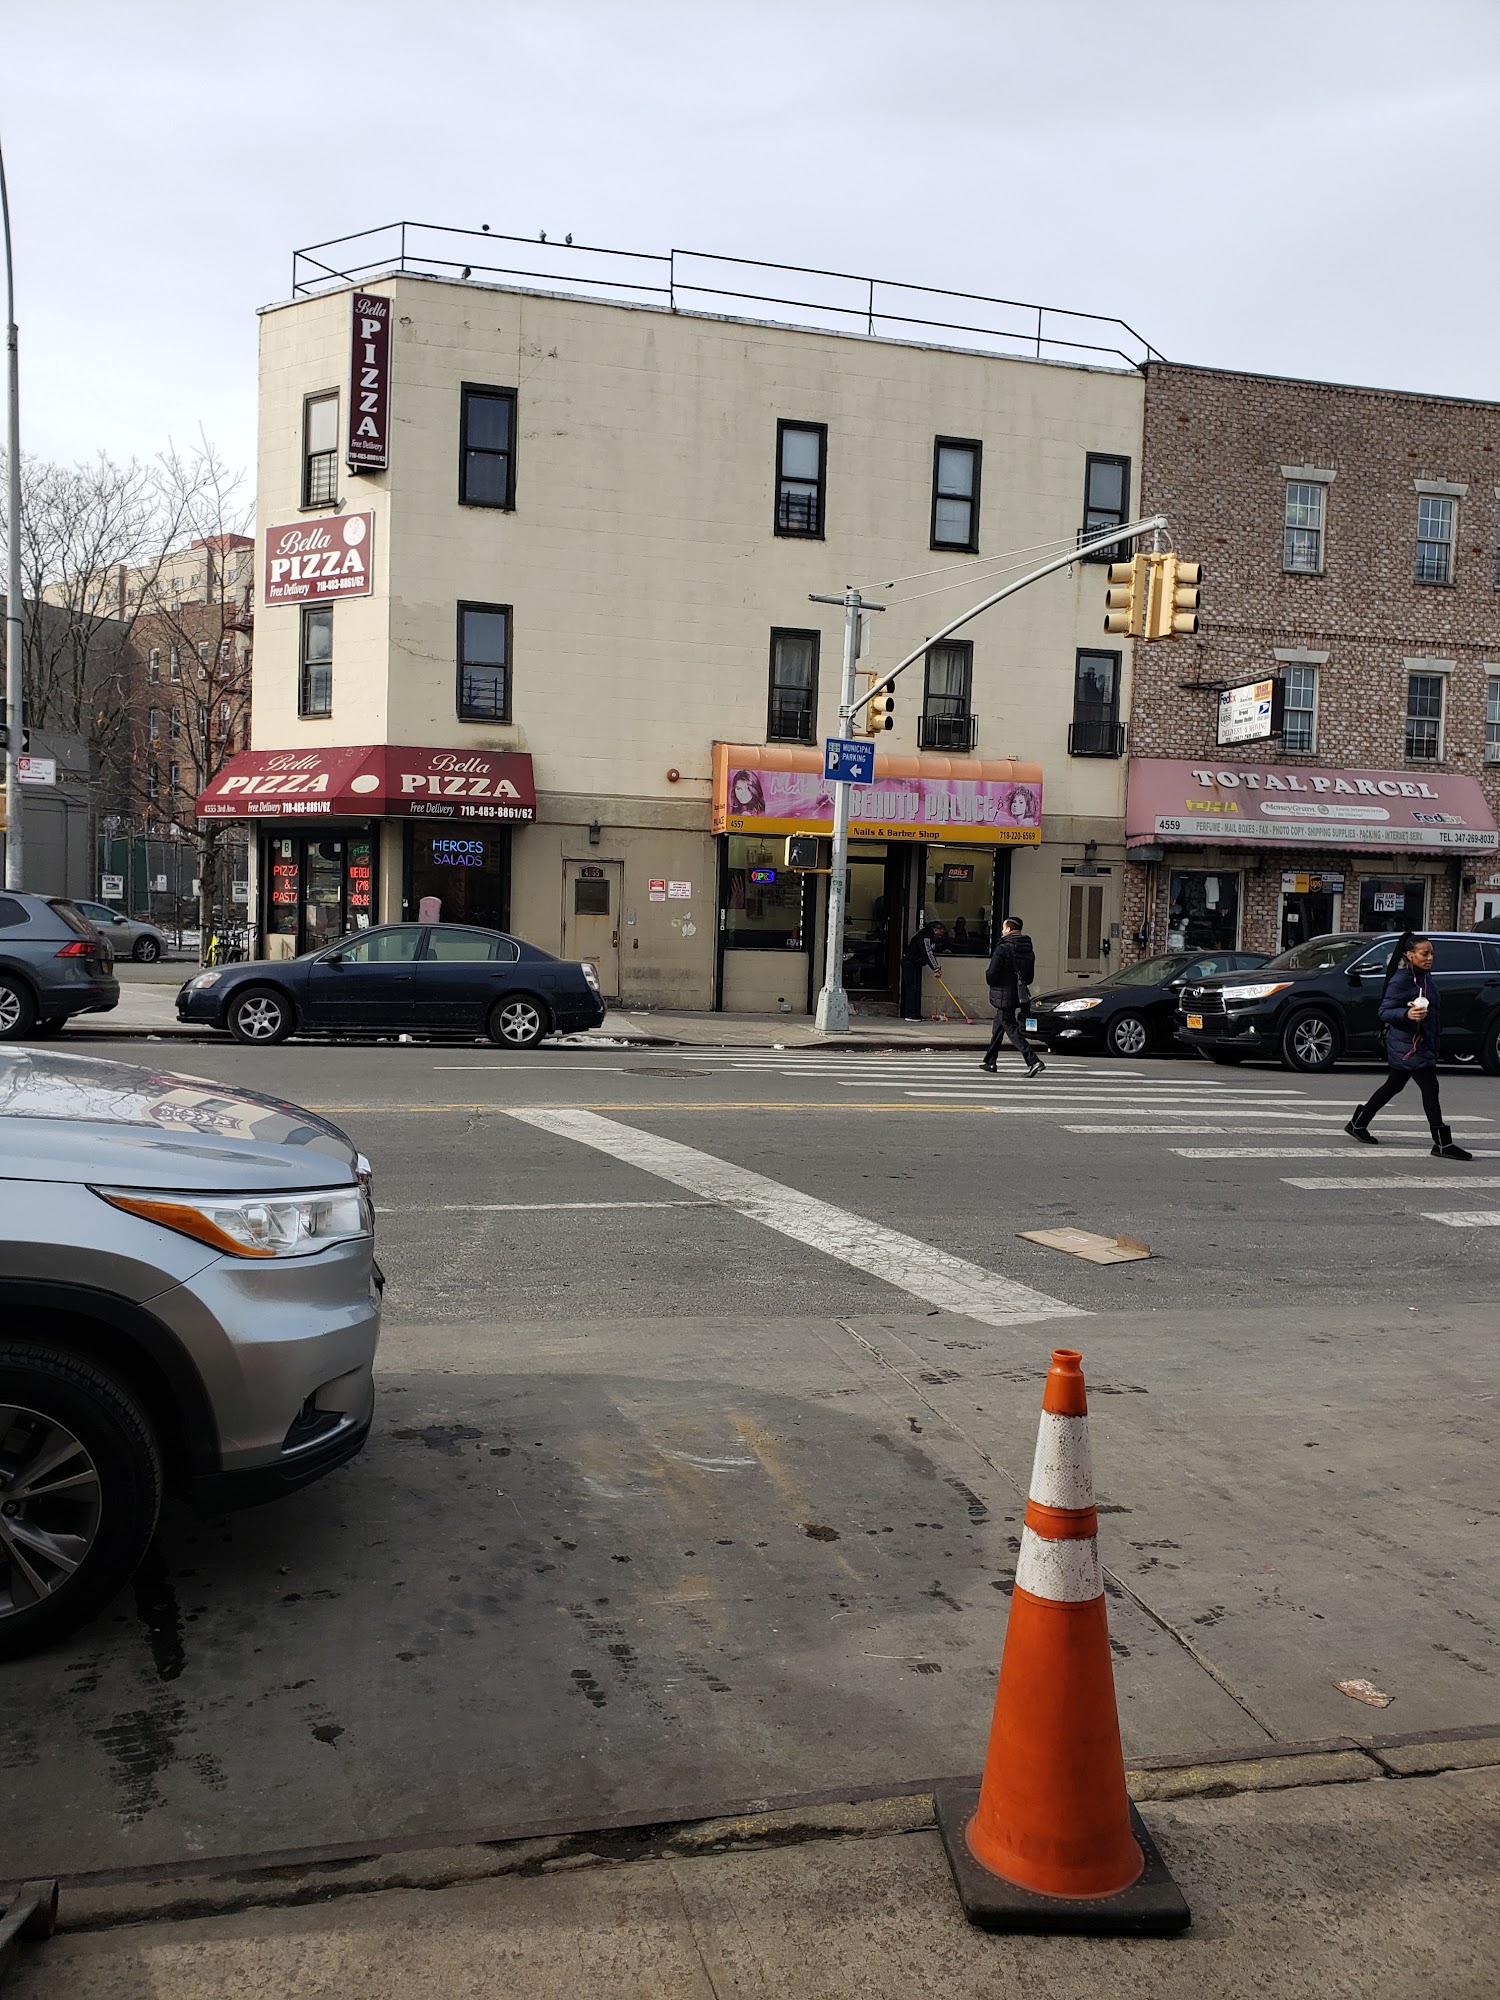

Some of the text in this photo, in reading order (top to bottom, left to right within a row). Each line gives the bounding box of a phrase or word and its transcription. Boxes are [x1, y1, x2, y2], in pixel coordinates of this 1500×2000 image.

[355, 299, 387, 317] Bella
[356, 318, 381, 438] PIZZA
[351, 439, 383, 452] Free Delivery
[276, 528, 332, 555] Bella
[270, 549, 365, 583] PIZZA
[270, 585, 283, 597] Free
[284, 583, 310, 597] Delivery
[843, 743, 872, 755] MUNICIPAL
[259, 753, 322, 771] Bella
[428, 753, 492, 773] Bella
[842, 753, 867, 763] PARKING
[216, 773, 329, 795] PIZZA
[400, 773, 521, 798] PIZZA
[1191, 769, 1439, 799] TOTAL PARCEL
[204, 804, 216, 813] 4555
[216, 804, 226, 813] 3rd
[247, 801, 259, 813] Free
[259, 801, 281, 814] Delivery
[410, 801, 425, 813] Free
[425, 802, 455, 816] Delivery
[849, 790, 995, 822] BEAUTY PALACE
[1266, 803, 1316, 814] MoneyGram
[730, 820, 744, 829] 4557
[1159, 820, 1181, 830] 4559
[1411, 811, 1467, 825] FedEx
[853, 827, 940, 840] Nails & Barber Shop
[1000, 830, 1035, 841] 718-220-6569
[1196, 821, 1423, 841] PERFUME MAIL BOXES FAX PHOTO COPY SHIPPING SUPPLIES PACKING INTERNET SERV.
[1439, 832, 1495, 844] TEL. 347-269-8032
[284, 842, 290, 853] B
[432, 839, 484, 854] HEROES
[433, 853, 483, 867] SALADS
[751, 870, 776, 882] OPE
[284, 879, 292, 890] &
[1310, 880, 1323, 890] ups
